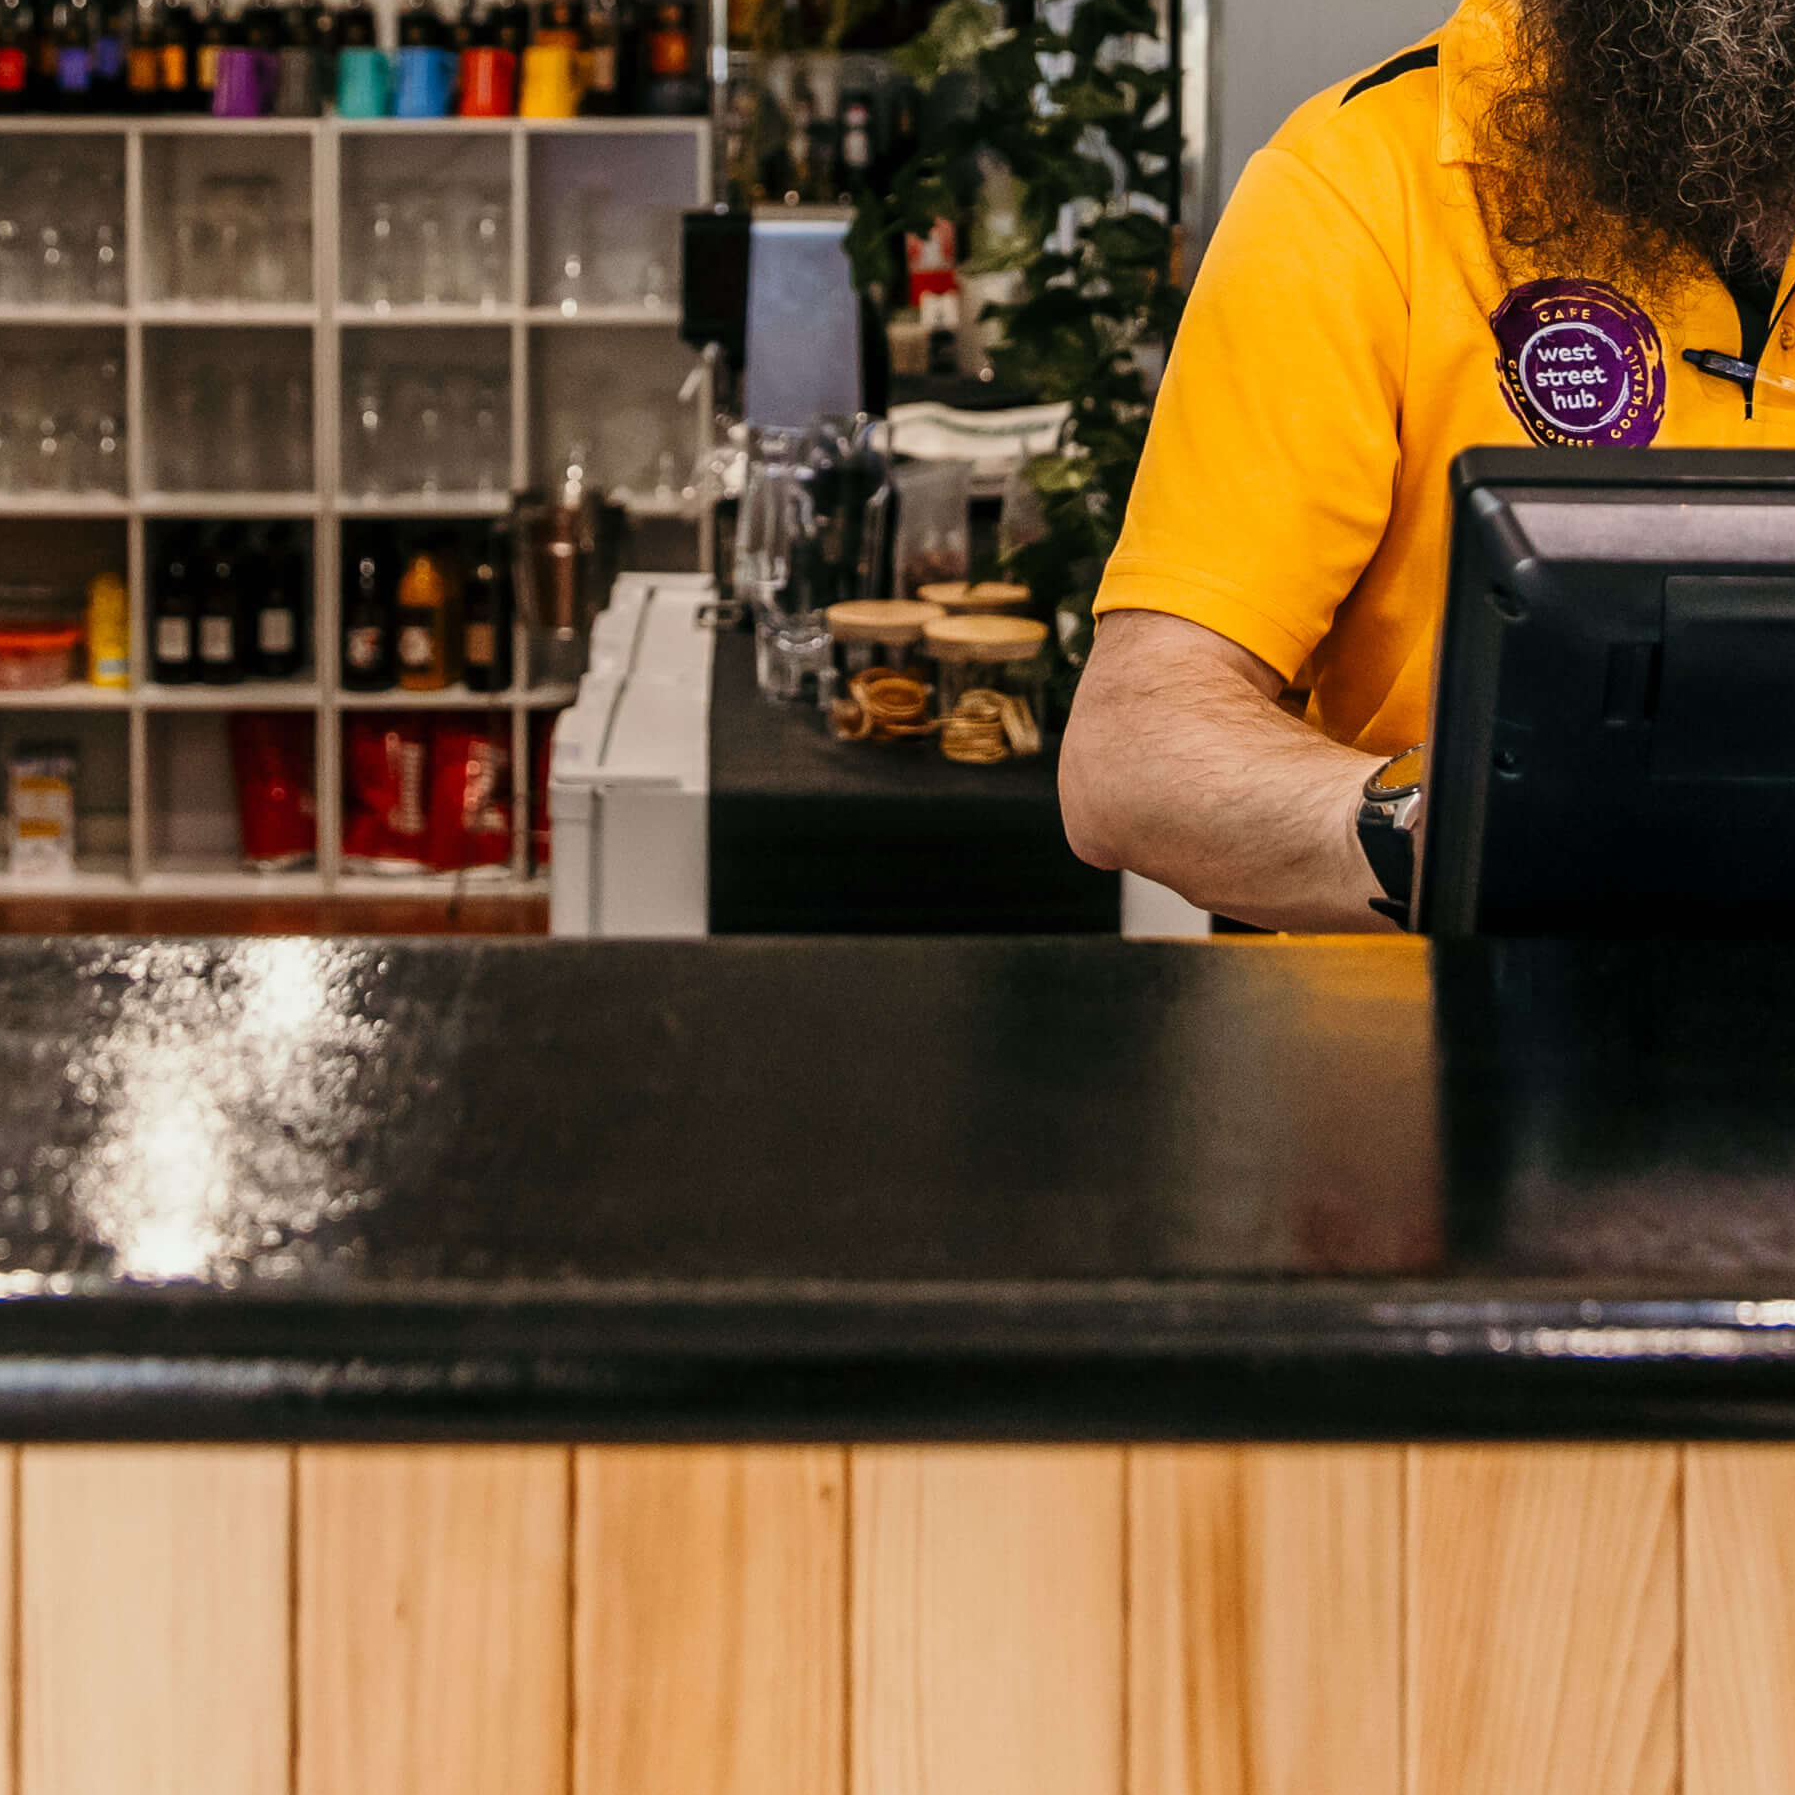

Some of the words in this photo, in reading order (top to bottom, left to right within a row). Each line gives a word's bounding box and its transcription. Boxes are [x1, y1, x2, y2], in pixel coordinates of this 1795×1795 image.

[1538, 307, 1592, 323] CAFE
[1537, 342, 1597, 363] west
[1507, 359, 1527, 403] CAKE
[1535, 365, 1608, 387] street
[1550, 388, 1603, 411] hub.
